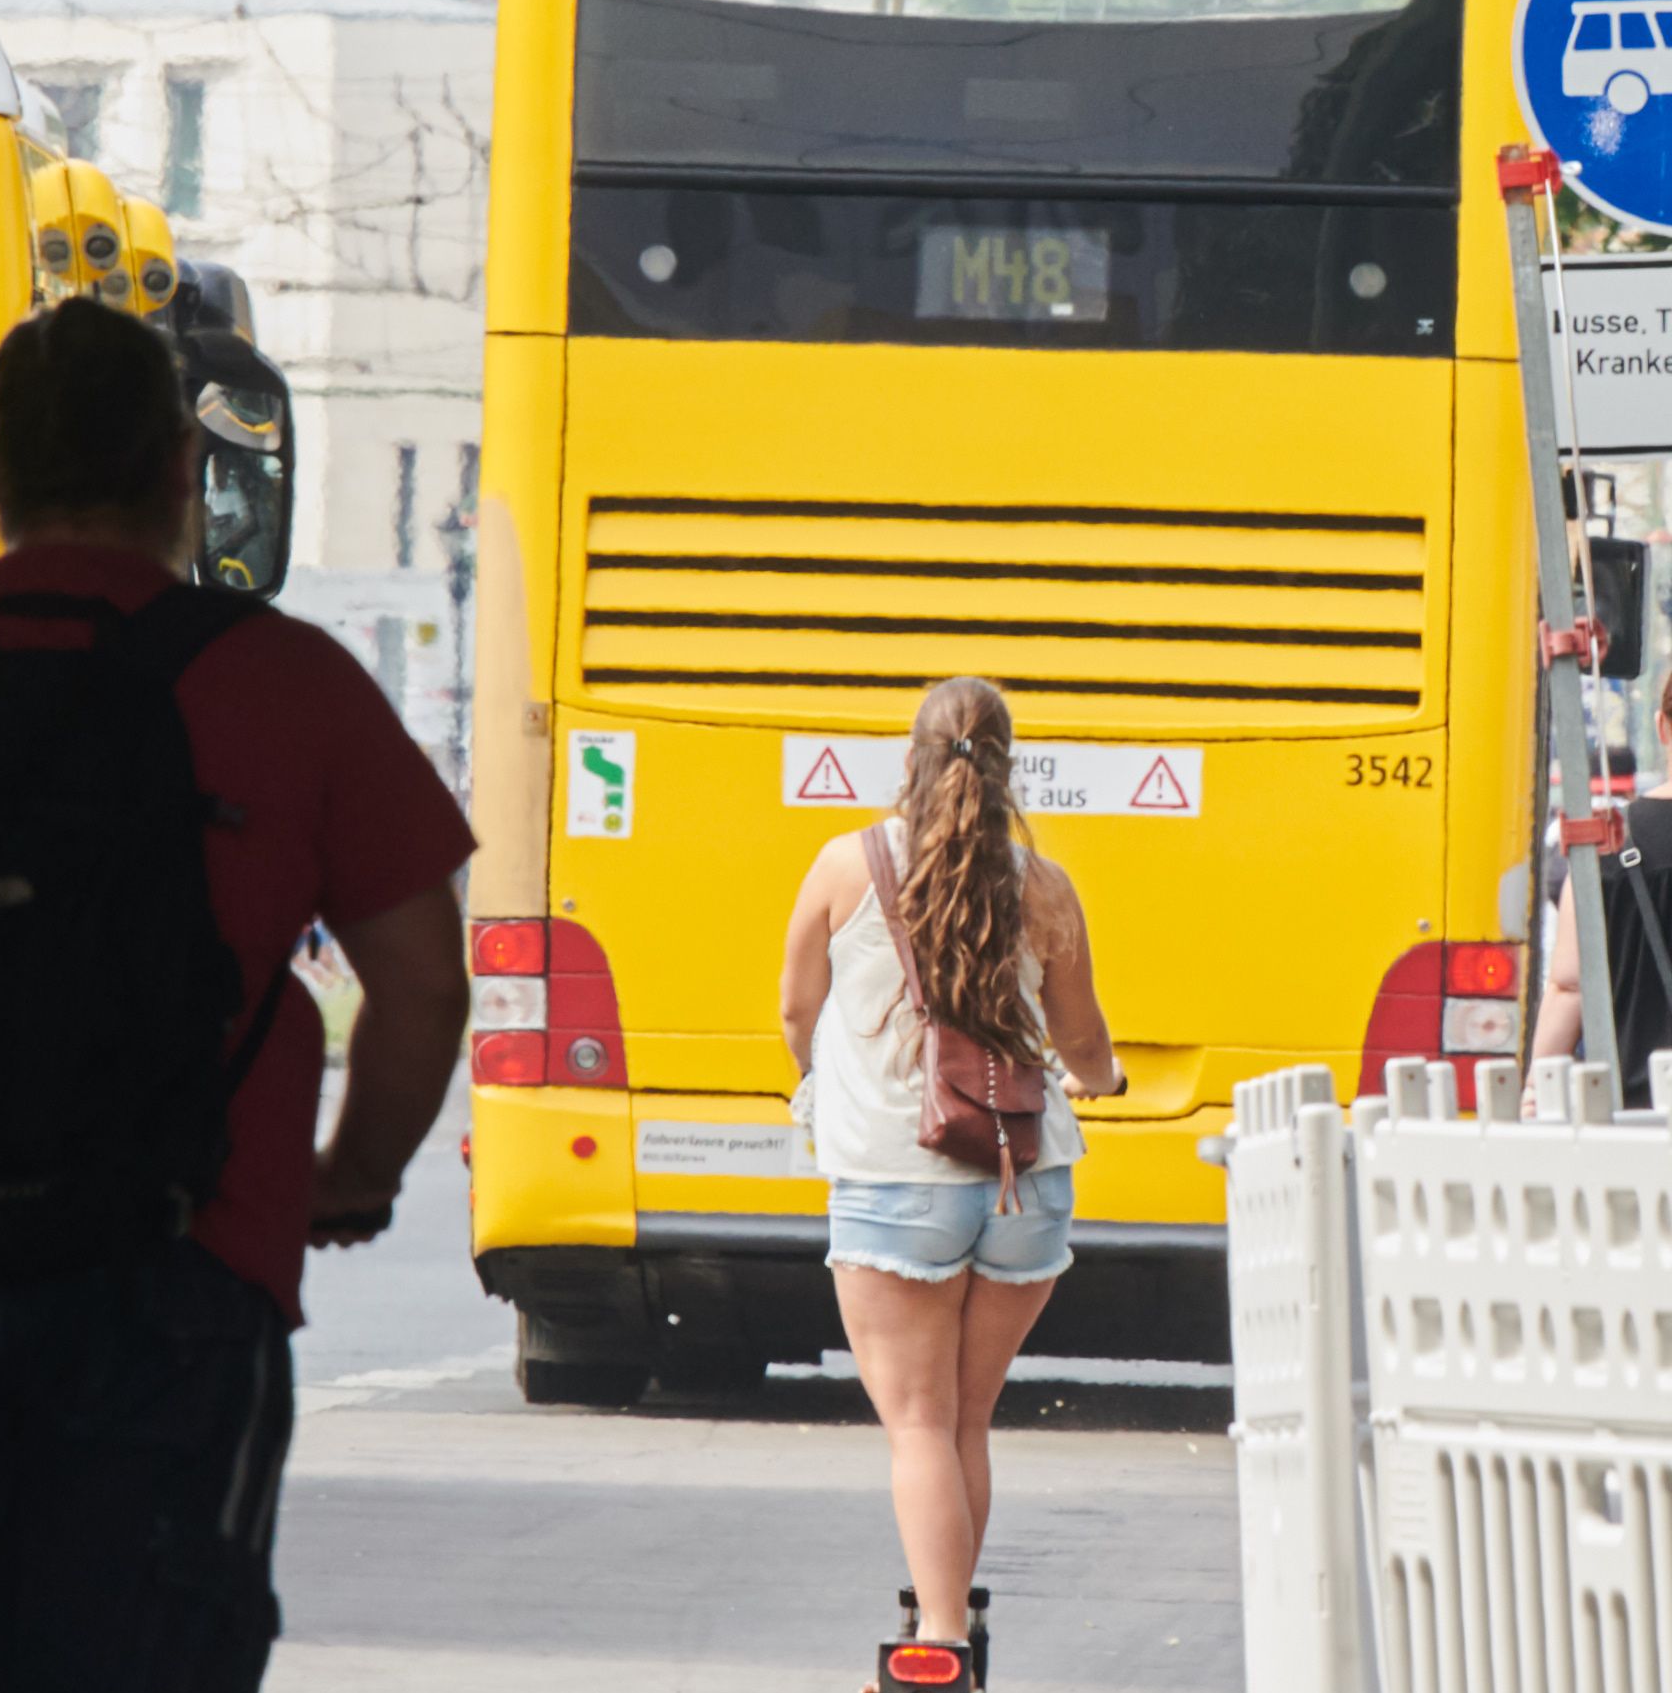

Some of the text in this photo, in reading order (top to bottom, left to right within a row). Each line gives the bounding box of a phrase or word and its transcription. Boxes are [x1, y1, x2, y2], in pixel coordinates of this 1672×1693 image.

[952, 236, 1069, 304] M48
[1345, 754, 1432, 787] 3542
[1039, 787, 1087, 808] aus
